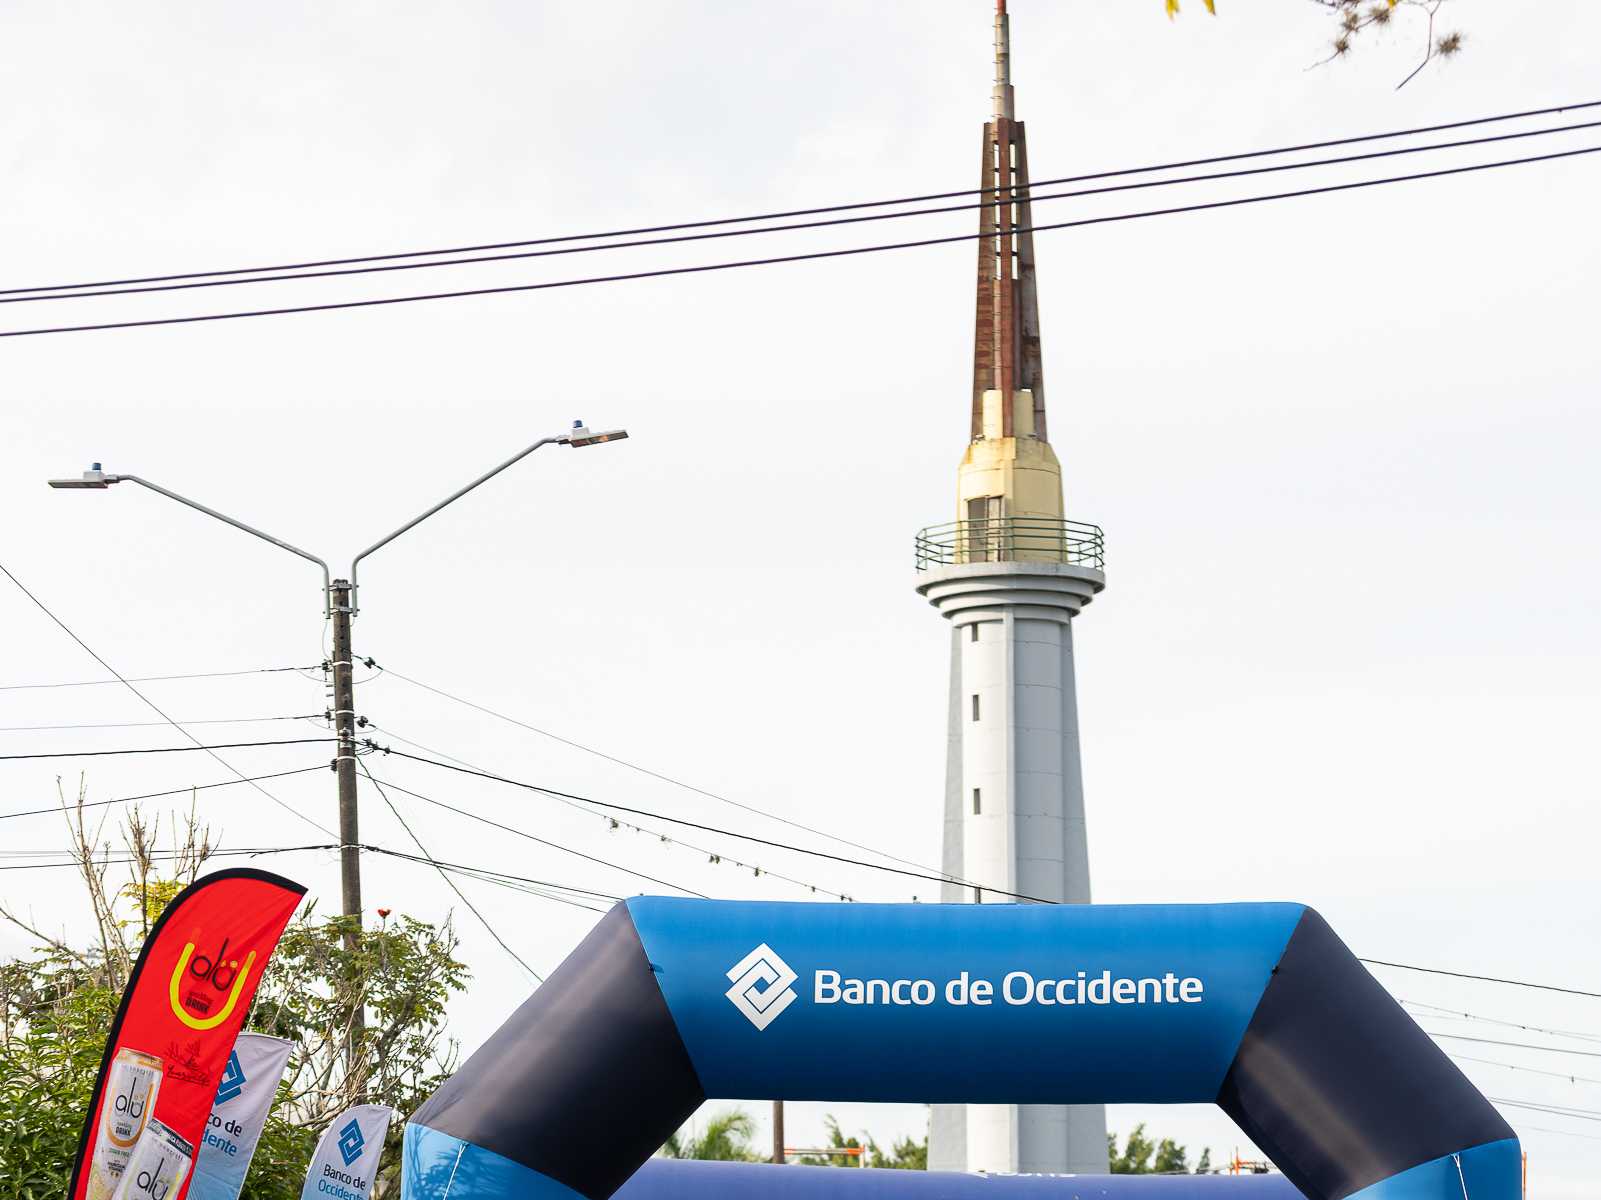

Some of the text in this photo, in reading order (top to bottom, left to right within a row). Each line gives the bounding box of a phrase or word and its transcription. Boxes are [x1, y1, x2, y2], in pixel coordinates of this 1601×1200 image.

[813, 969, 1203, 1005] Banco de Occidente
[225, 1119, 242, 1137] de
[323, 1164, 366, 1191] Banco de
